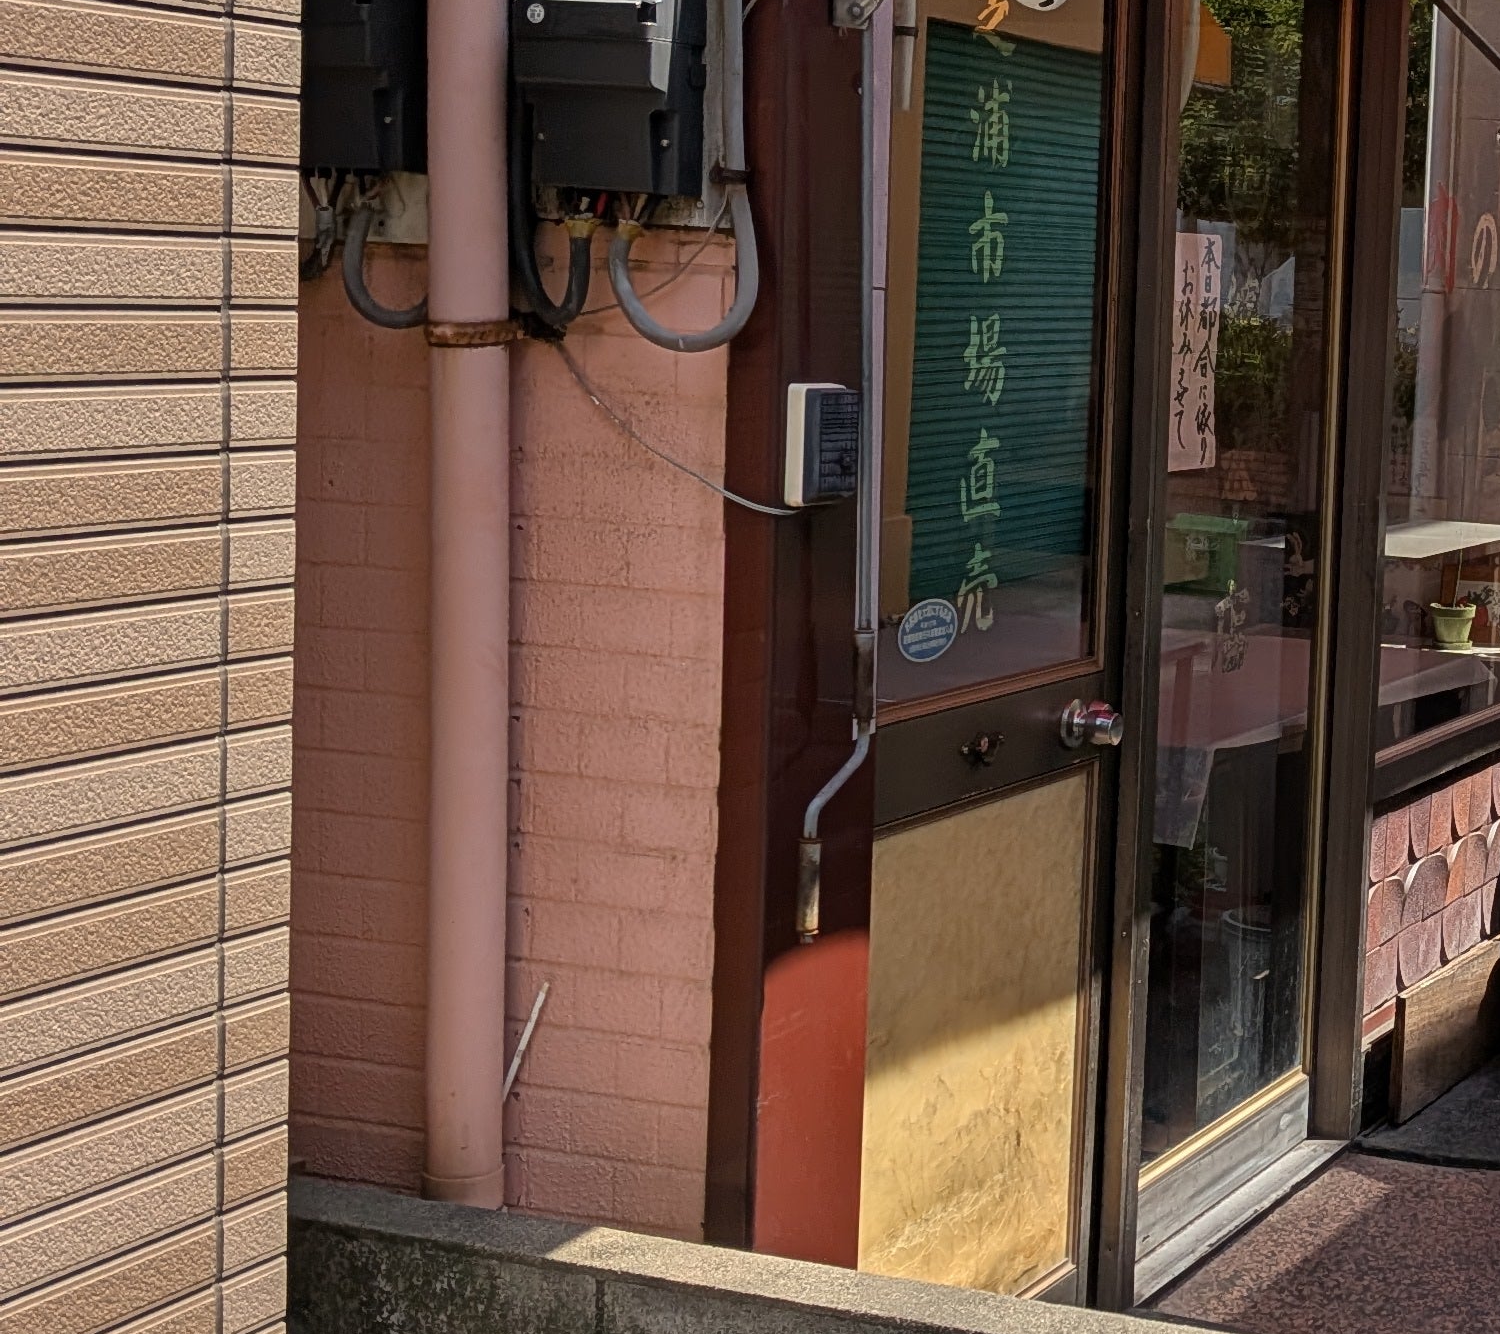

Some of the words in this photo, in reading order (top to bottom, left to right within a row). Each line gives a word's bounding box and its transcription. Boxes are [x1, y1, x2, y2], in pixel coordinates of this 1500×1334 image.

[1174, 260, 1195, 450] お休みさせて
[1193, 237, 1220, 465] 本日都合に依り
